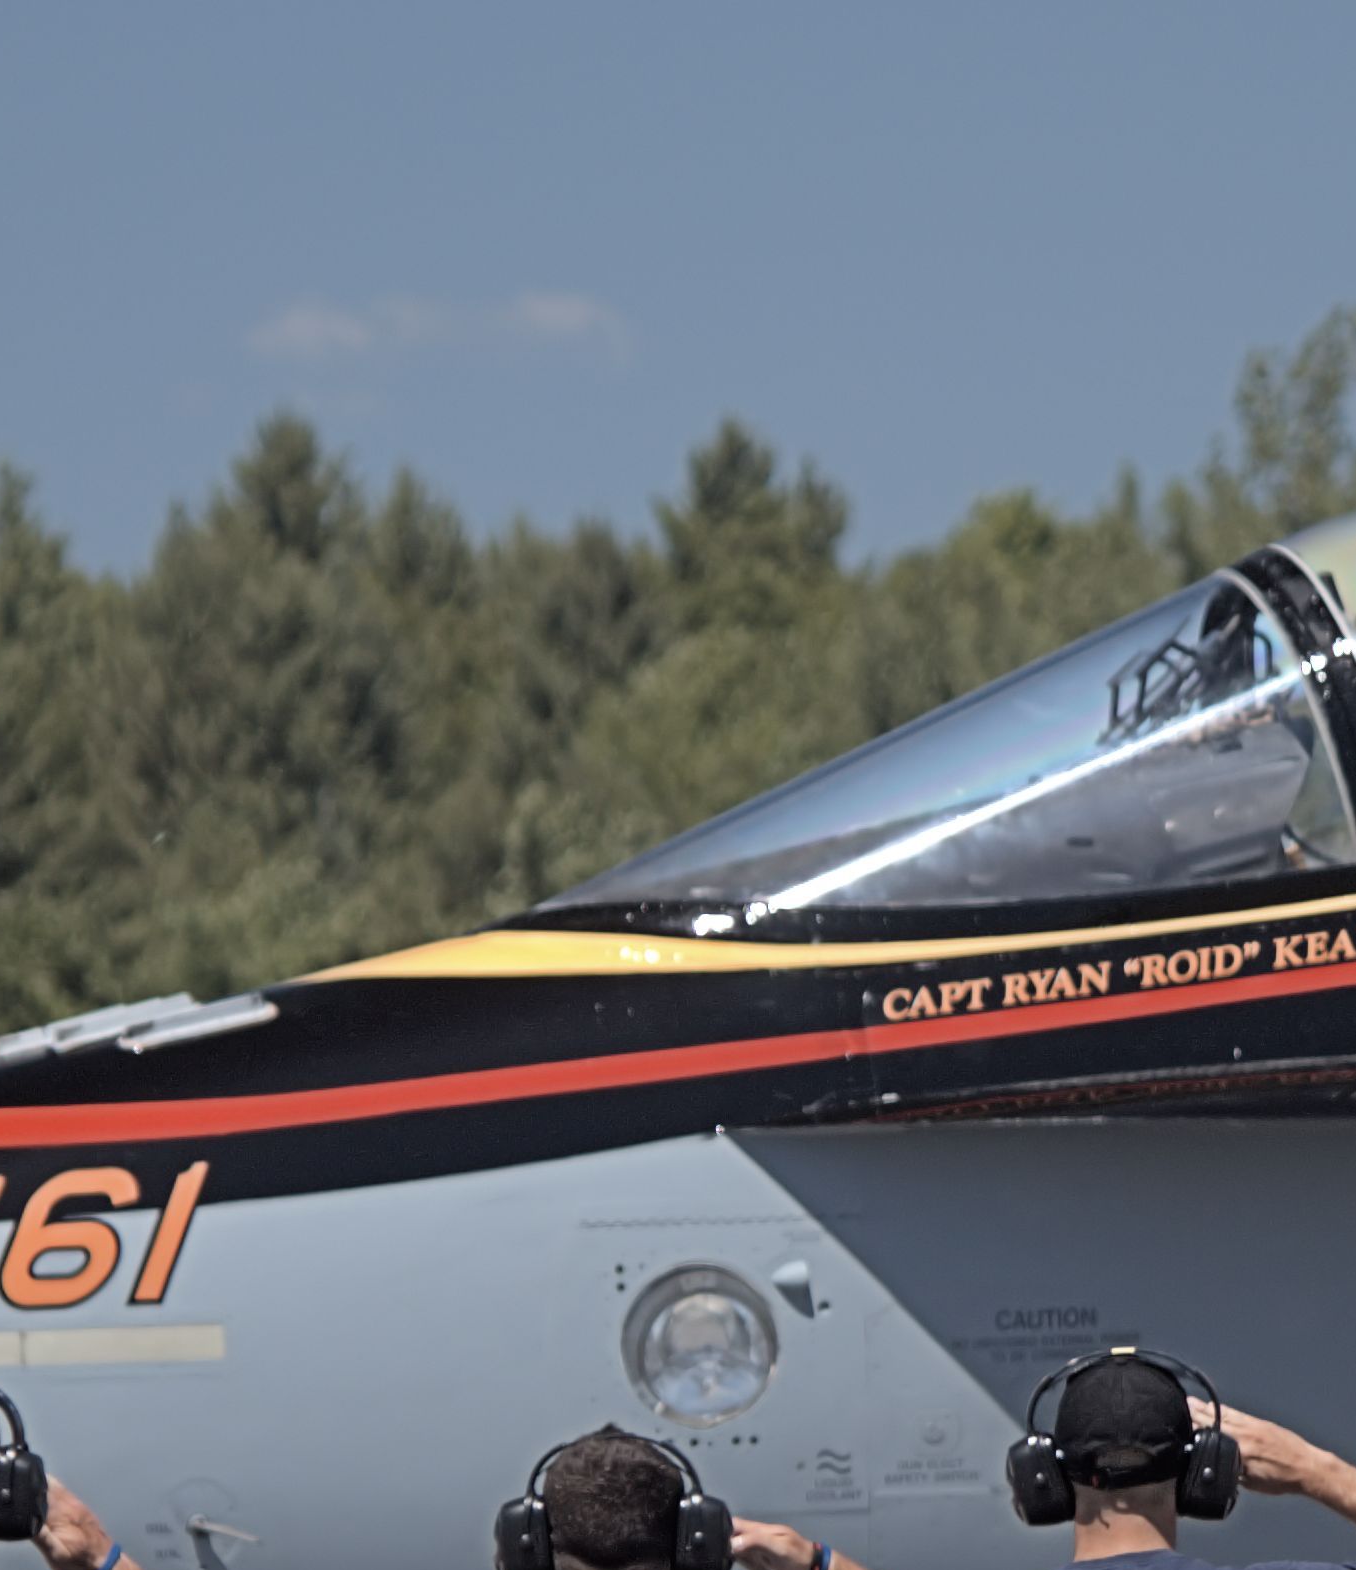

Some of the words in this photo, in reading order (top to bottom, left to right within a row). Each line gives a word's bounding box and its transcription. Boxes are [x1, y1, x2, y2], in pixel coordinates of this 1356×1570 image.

[883, 977, 992, 1020] CAPT
[1002, 960, 1112, 1007] RYAN
[995, 1307, 1097, 1330] CAUTION
